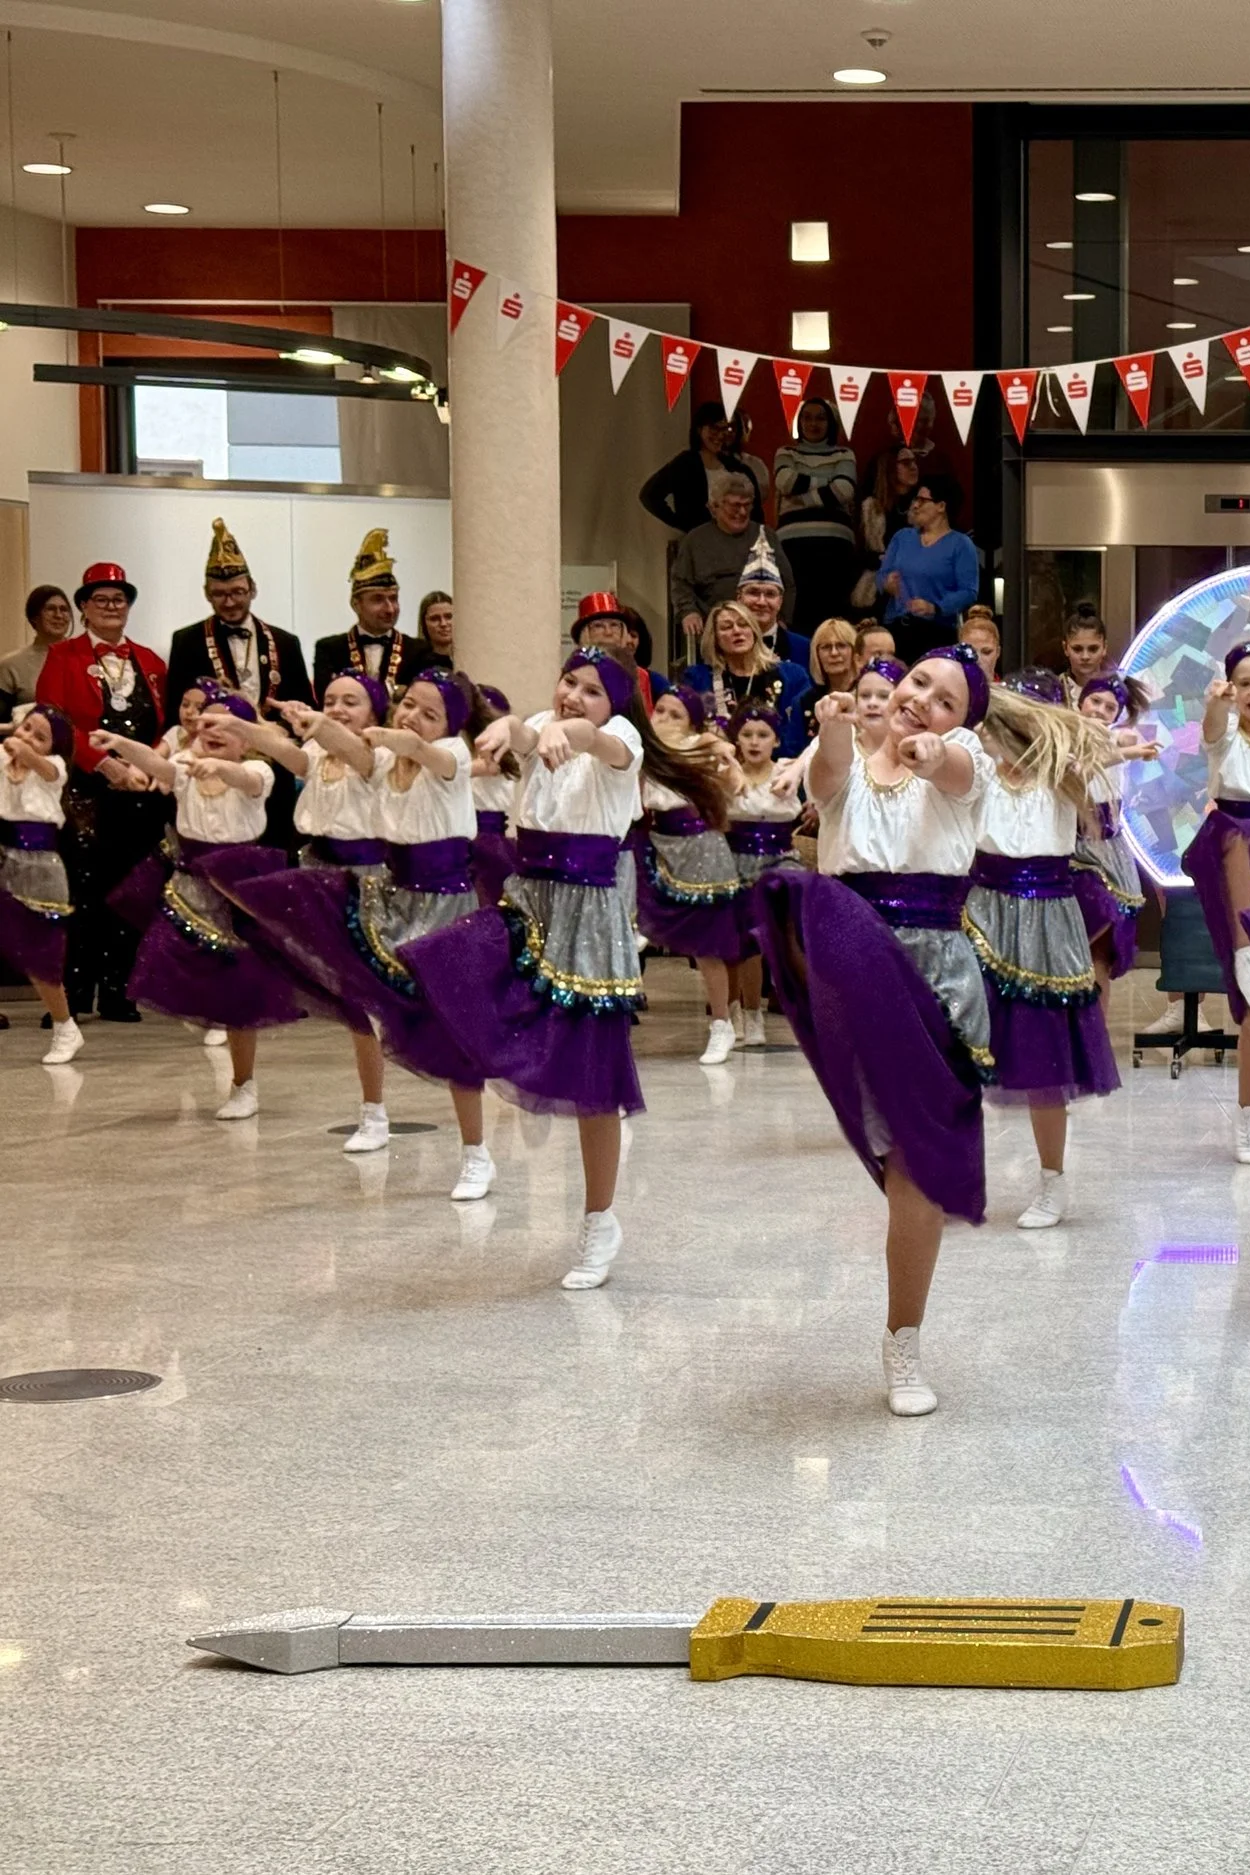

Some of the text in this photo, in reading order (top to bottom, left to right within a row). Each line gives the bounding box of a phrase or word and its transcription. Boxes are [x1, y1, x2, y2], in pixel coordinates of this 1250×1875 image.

[453, 272, 473, 300] S
[502, 292, 523, 319] S
[557, 314, 580, 342] S
[613, 331, 635, 358] S
[666, 346, 689, 374] S
[723, 359, 744, 386] S
[1182, 352, 1204, 379] S
[781, 368, 802, 396] S
[839, 376, 860, 402] S
[1067, 372, 1088, 399] S
[1126, 363, 1148, 391] S
[896, 378, 918, 407] S
[953, 380, 973, 406] S
[1006, 377, 1029, 406] S
